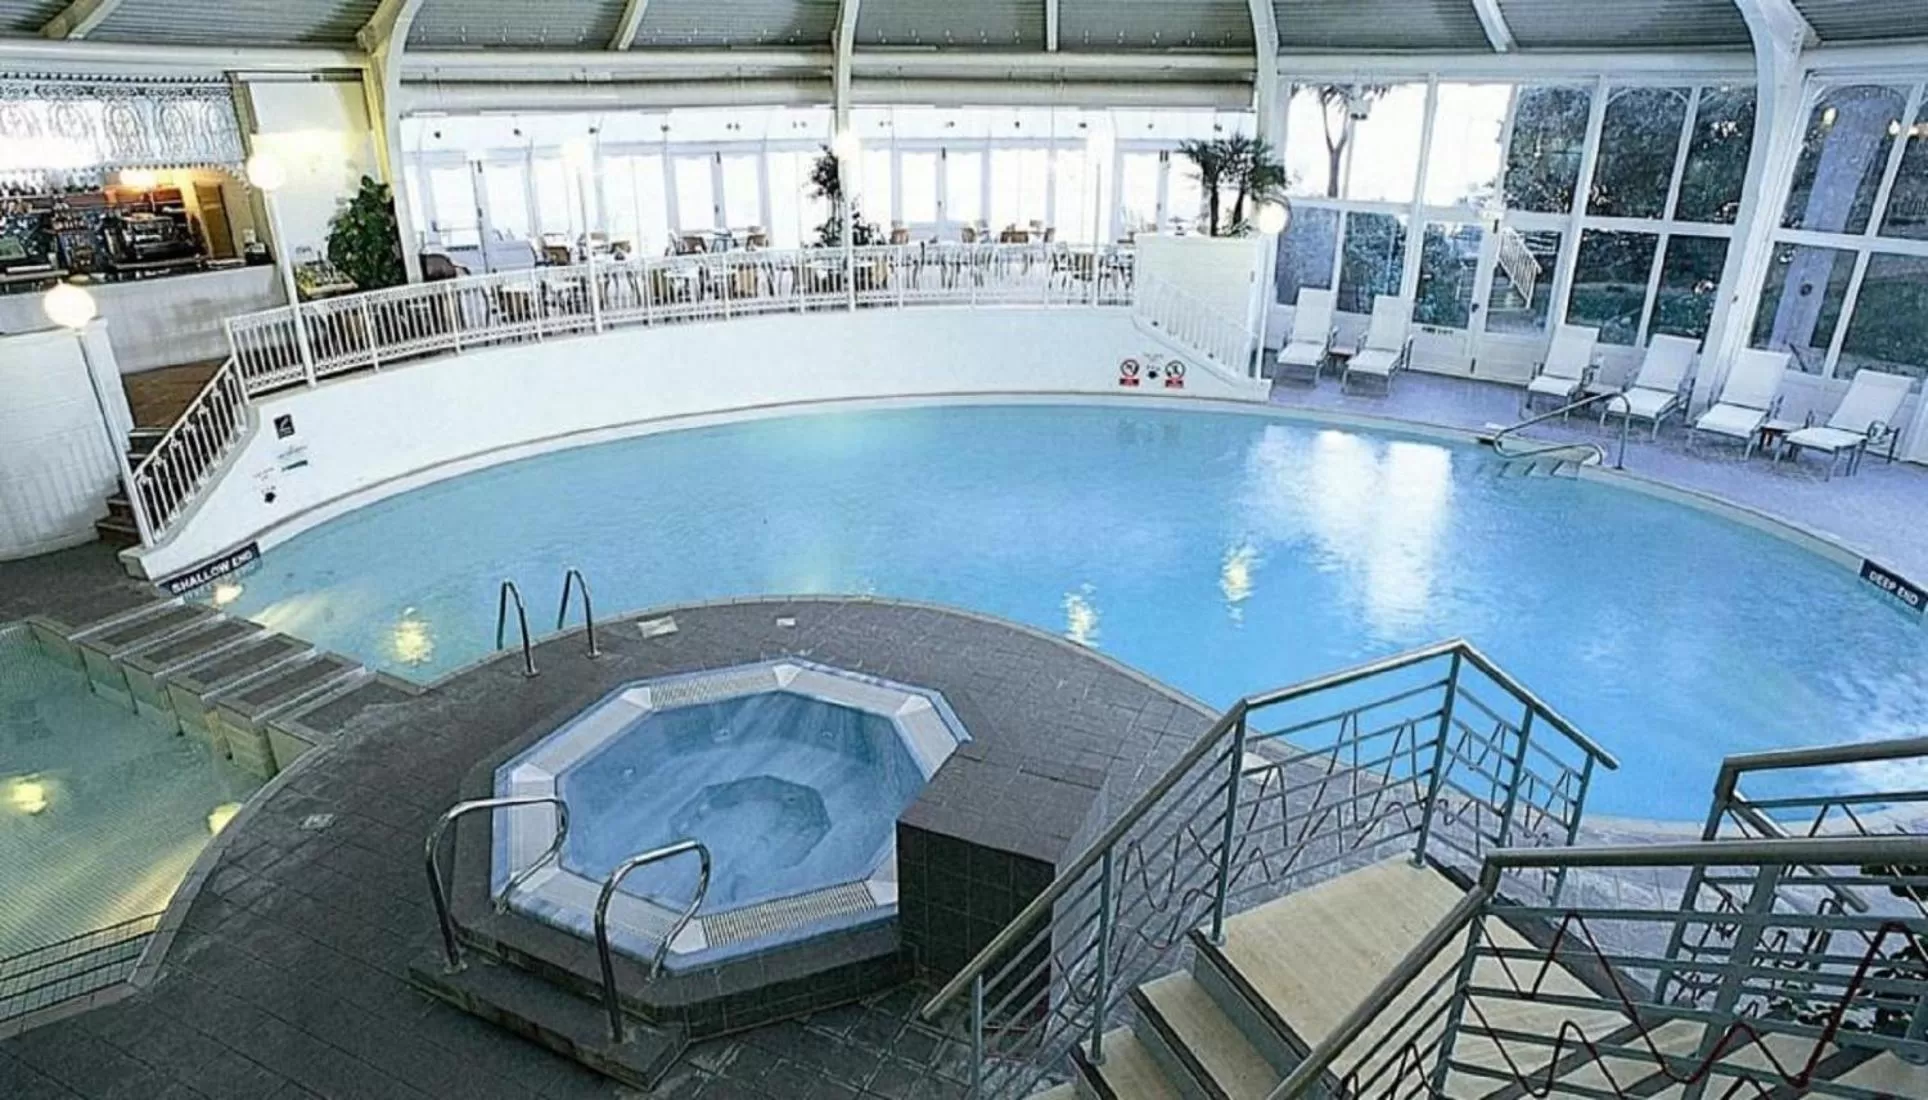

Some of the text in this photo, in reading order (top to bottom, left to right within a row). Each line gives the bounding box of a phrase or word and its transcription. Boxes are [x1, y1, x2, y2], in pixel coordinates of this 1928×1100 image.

[171, 549, 253, 594] SHALLOW END
[1869, 571, 1919, 605] DEEP END
